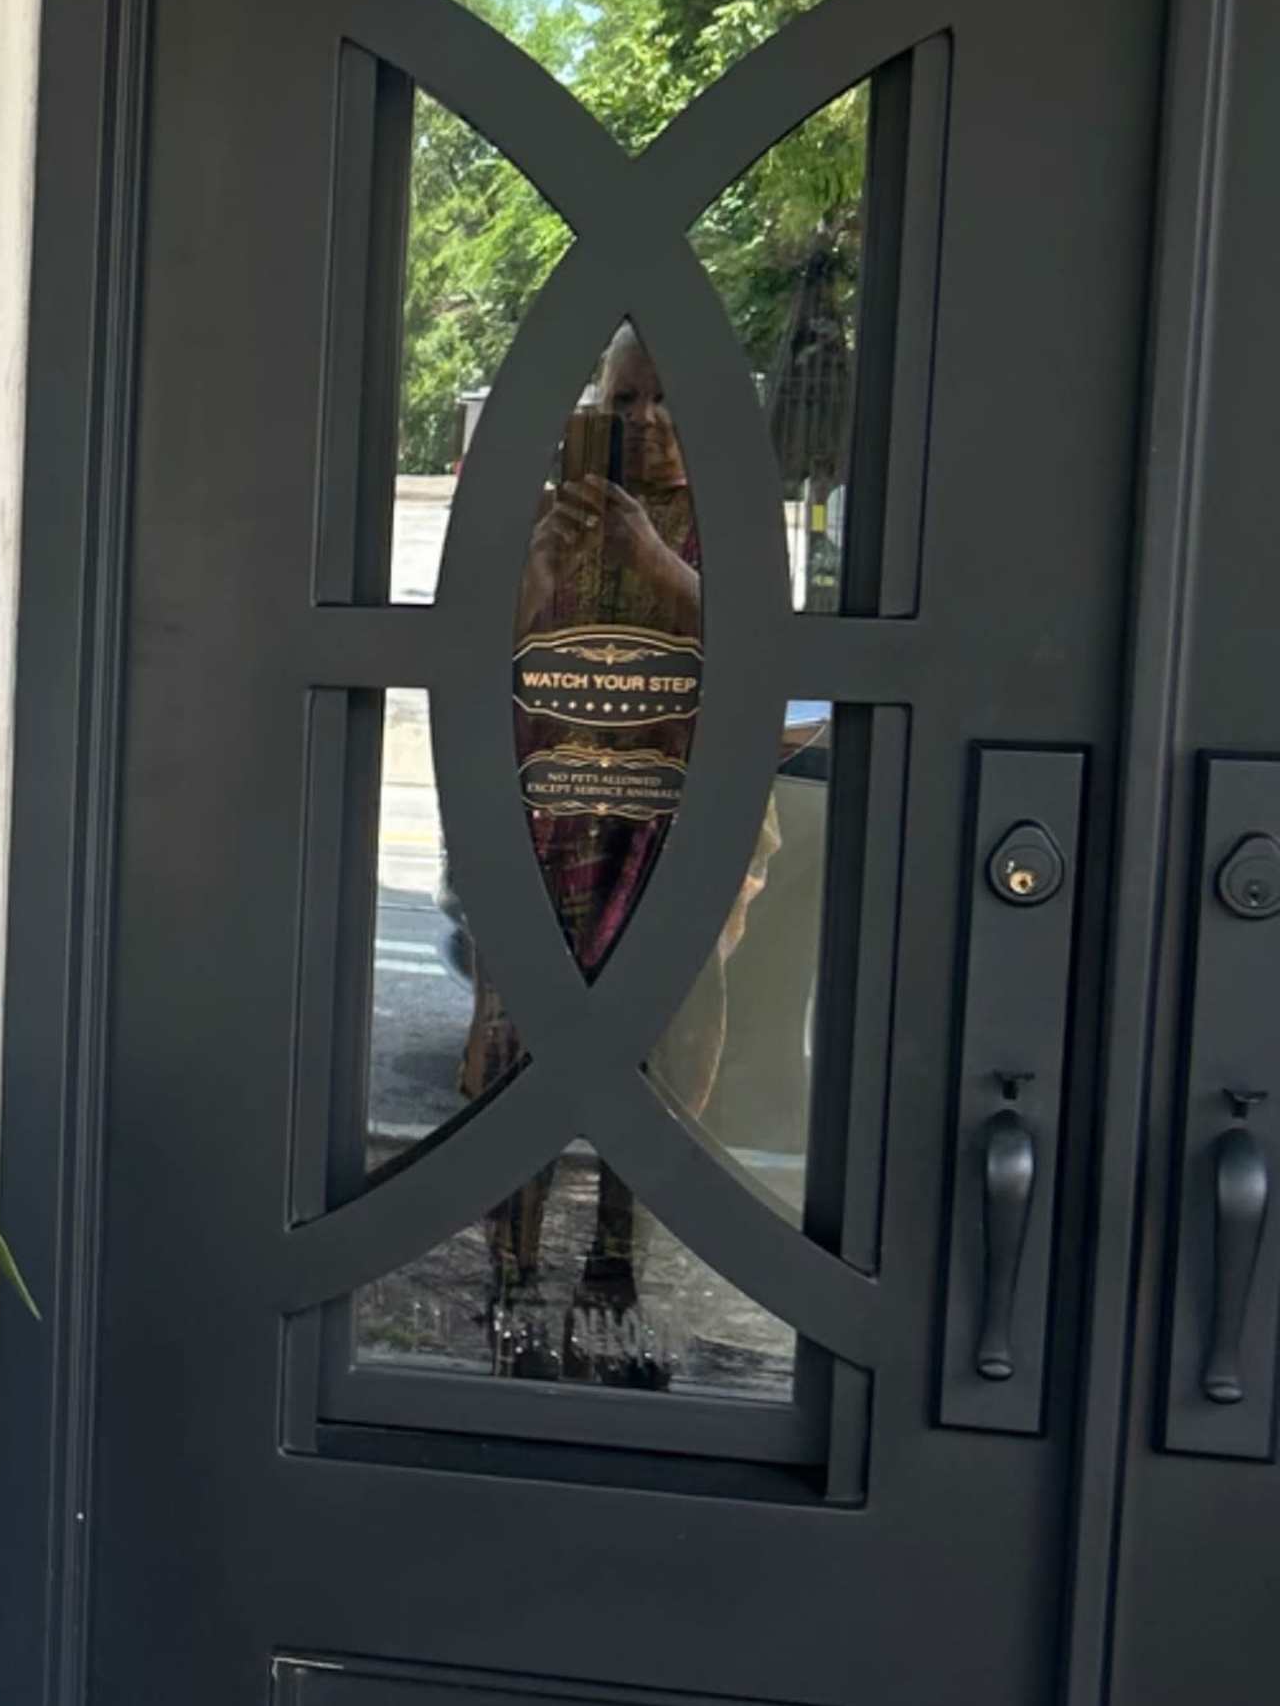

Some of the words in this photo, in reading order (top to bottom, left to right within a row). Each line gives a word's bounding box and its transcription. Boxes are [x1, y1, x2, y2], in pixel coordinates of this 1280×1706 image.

[522, 672, 588, 690] WATCH
[592, 675, 645, 691] YOUR
[649, 677, 697, 693] STEP
[547, 772, 568, 783] NO
[570, 773, 599, 785] PETS
[601, 774, 662, 787] ALLOWED
[527, 782, 572, 794] EXCEPT
[574, 785, 624, 797] SERVICE
